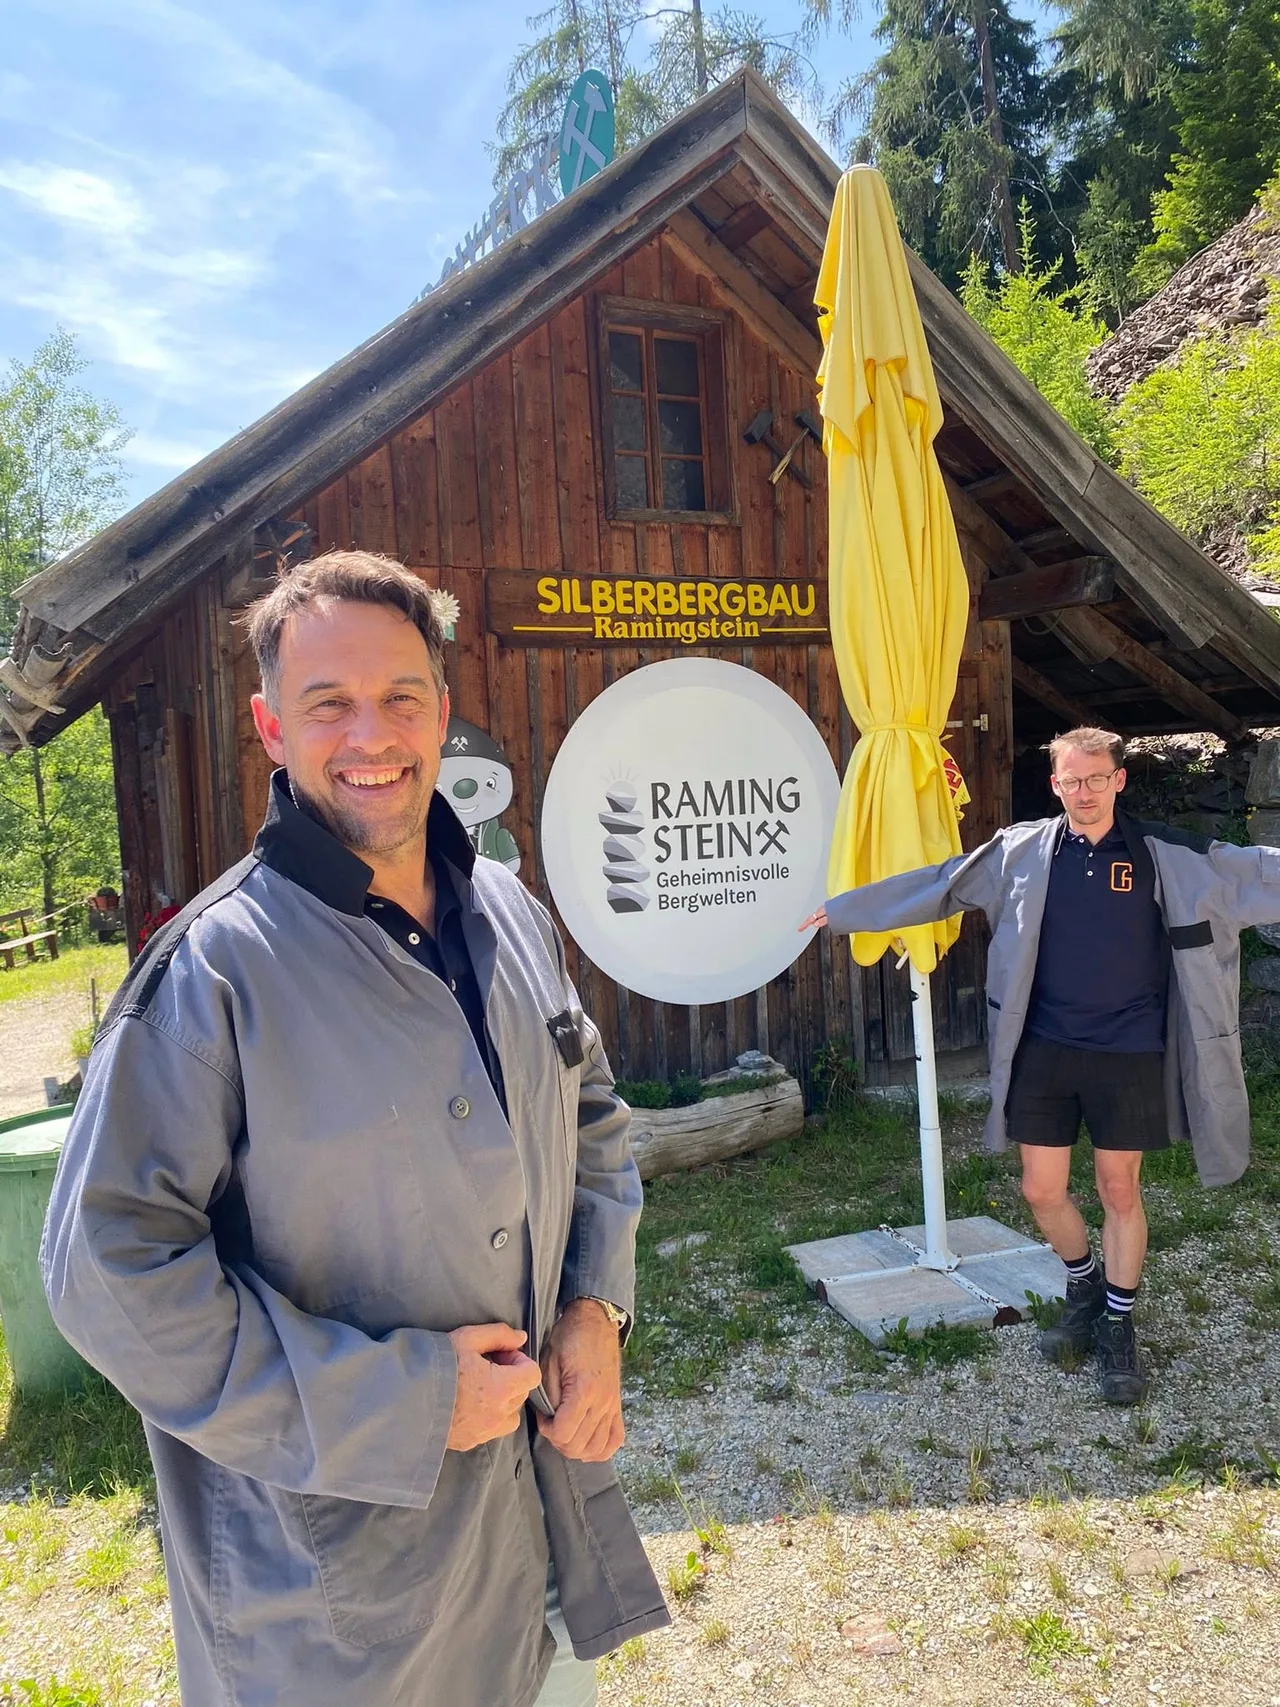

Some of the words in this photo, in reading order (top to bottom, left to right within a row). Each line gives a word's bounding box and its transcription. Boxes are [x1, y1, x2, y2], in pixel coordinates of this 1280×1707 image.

[536, 576, 816, 617] SILBERBERGBAU
[593, 615, 760, 644] Ramingstein
[650, 776, 801, 820] RAMING
[653, 821, 753, 864] STEIN
[656, 862, 790, 888] Geheimnisvolle
[658, 888, 757, 913] Bergwelten
